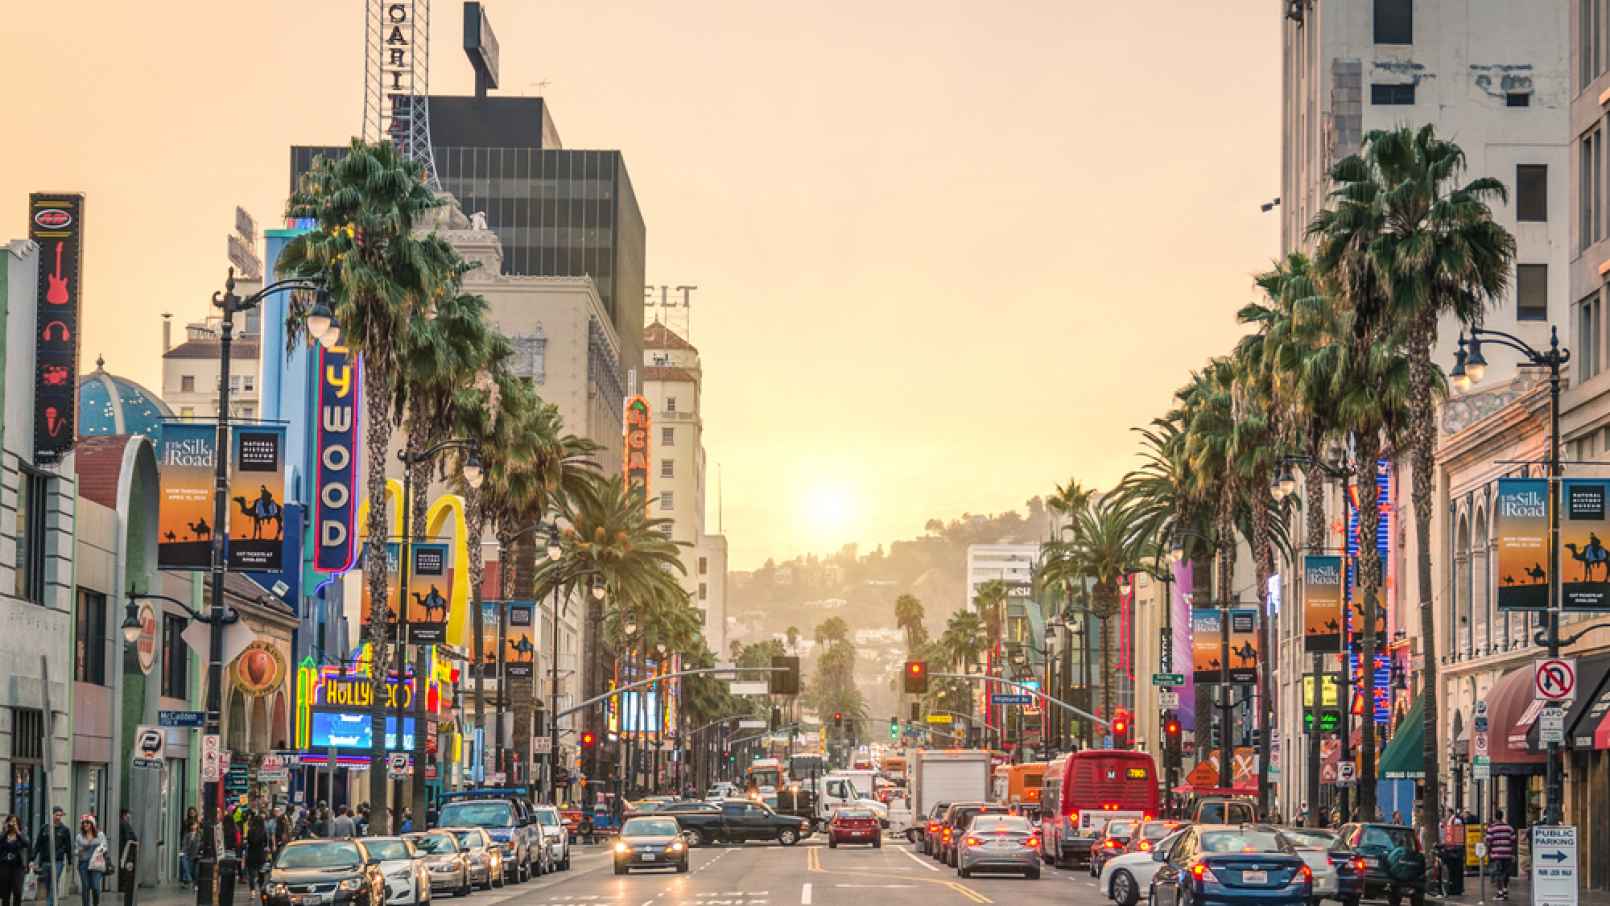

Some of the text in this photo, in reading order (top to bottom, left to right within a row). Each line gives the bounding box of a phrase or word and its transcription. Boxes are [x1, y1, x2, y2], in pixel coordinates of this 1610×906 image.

[182, 439, 209, 455] Silk
[171, 448, 213, 466] Road
[1517, 491, 1541, 505] Silk
[1506, 501, 1545, 517] Road
[326, 680, 412, 708] HOLLYOOD
[1536, 838, 1575, 846] PARKING
